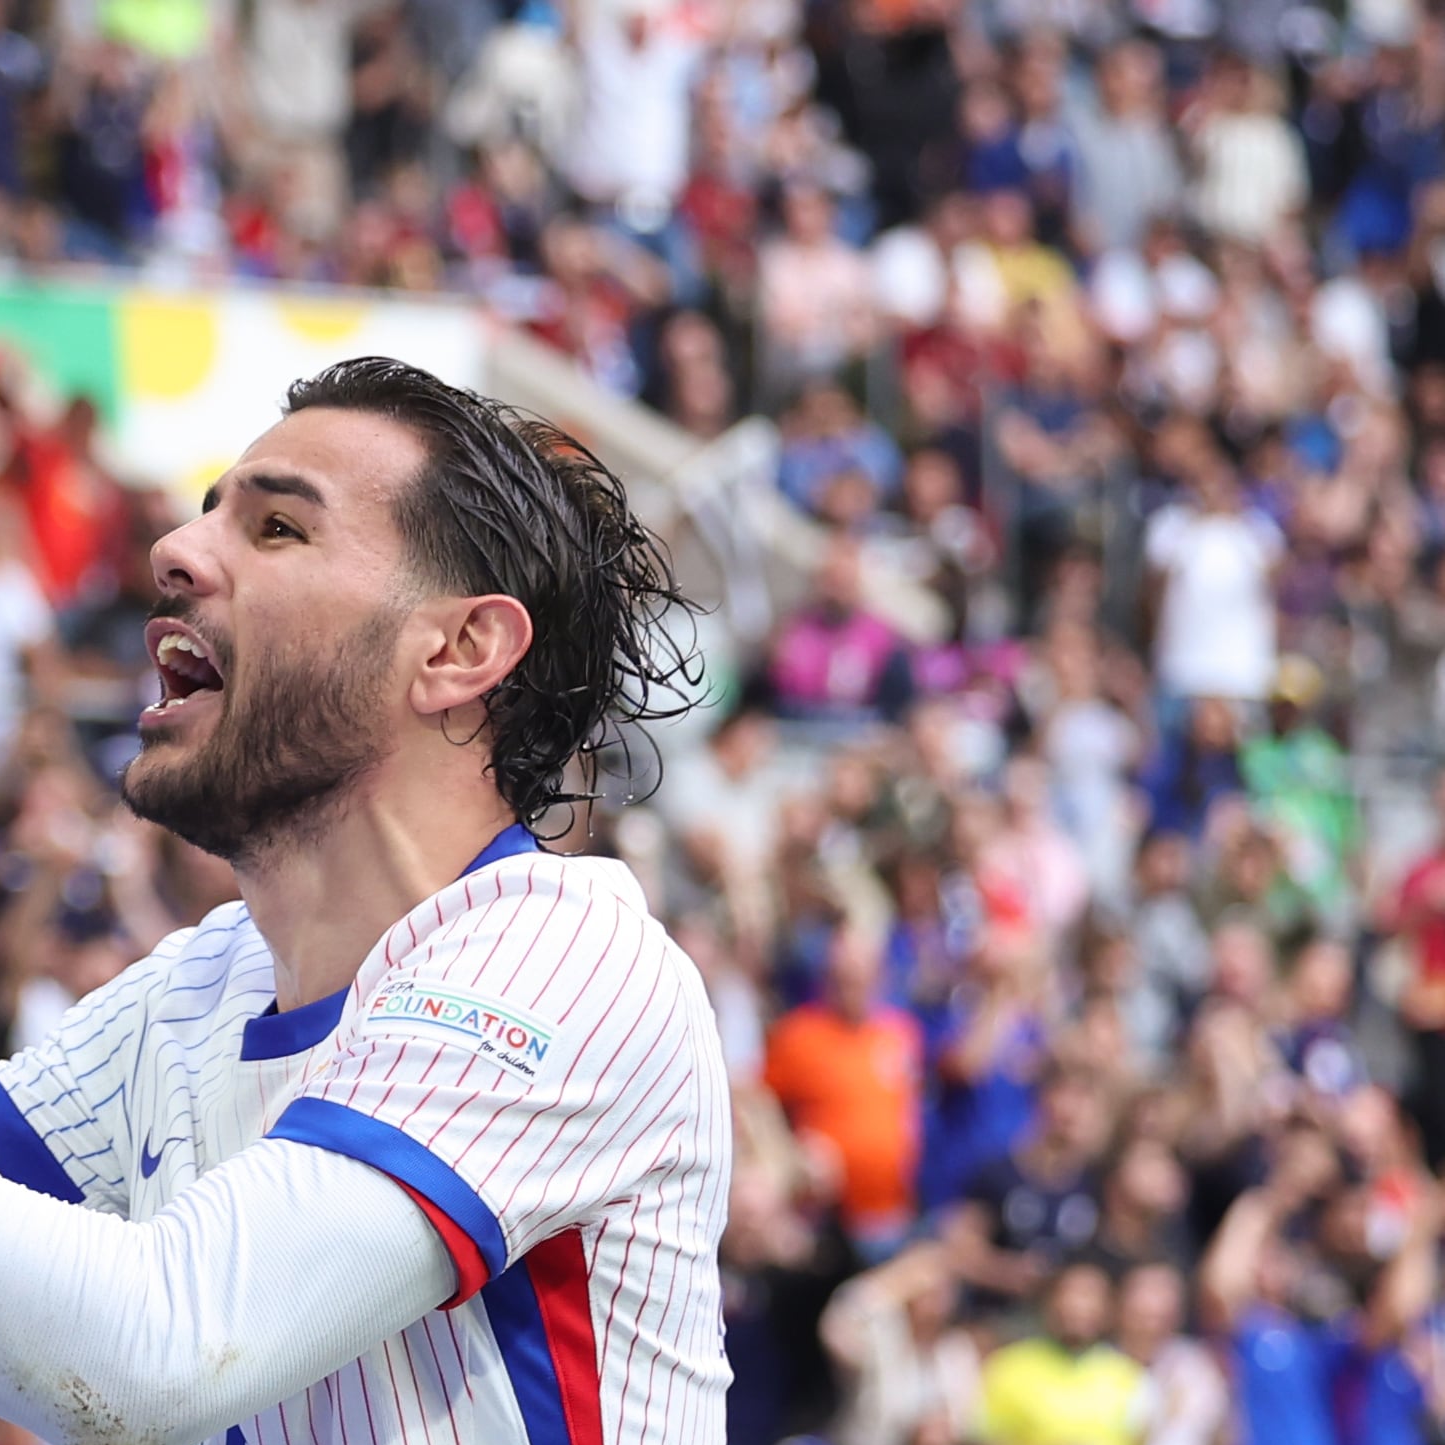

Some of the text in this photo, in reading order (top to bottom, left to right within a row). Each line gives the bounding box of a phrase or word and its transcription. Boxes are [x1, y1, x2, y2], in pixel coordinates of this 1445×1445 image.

[380, 981, 415, 994] UEFA
[478, 1039, 536, 1078] for children
